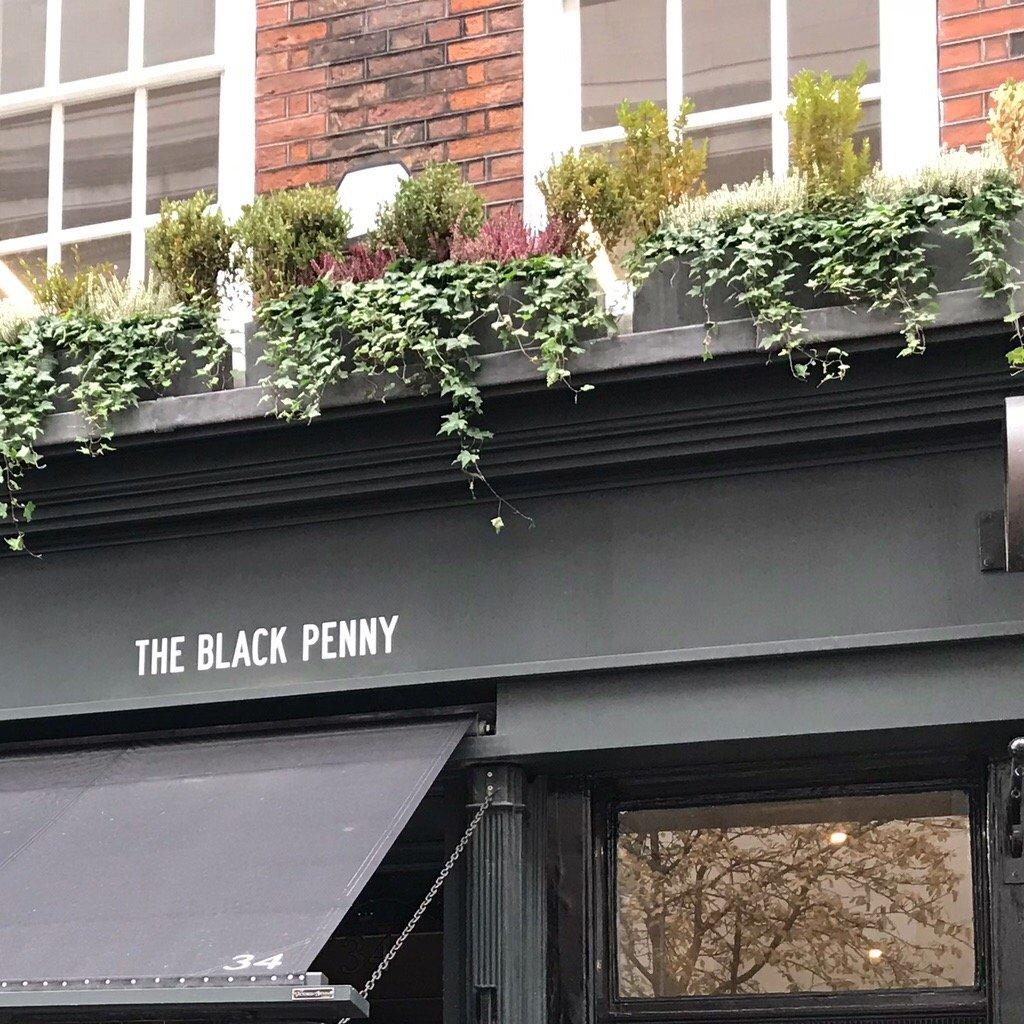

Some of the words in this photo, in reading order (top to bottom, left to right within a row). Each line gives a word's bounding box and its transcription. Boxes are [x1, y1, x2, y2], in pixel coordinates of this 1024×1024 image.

[135, 636, 186, 676] THE
[197, 626, 288, 671] BLACK
[302, 615, 399, 661] PENNY
[223, 953, 284, 970] 34
